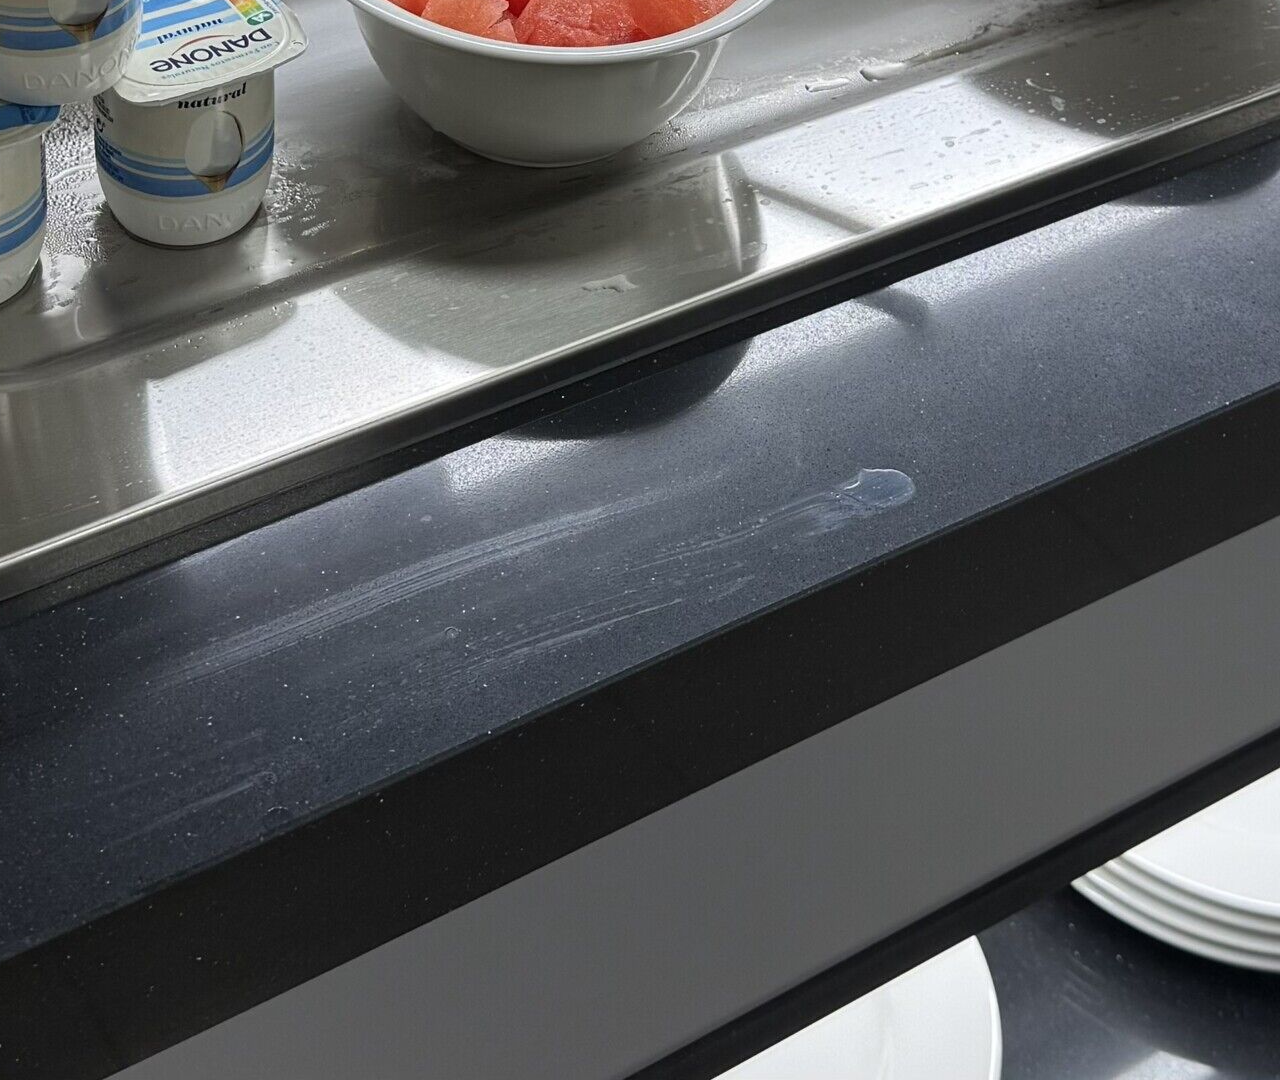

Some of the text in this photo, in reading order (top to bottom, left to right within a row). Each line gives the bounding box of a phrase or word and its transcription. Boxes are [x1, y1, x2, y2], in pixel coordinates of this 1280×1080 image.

[156, 17, 224, 45] natural
[149, 27, 273, 73] DANONE
[177, 82, 247, 110] natural
